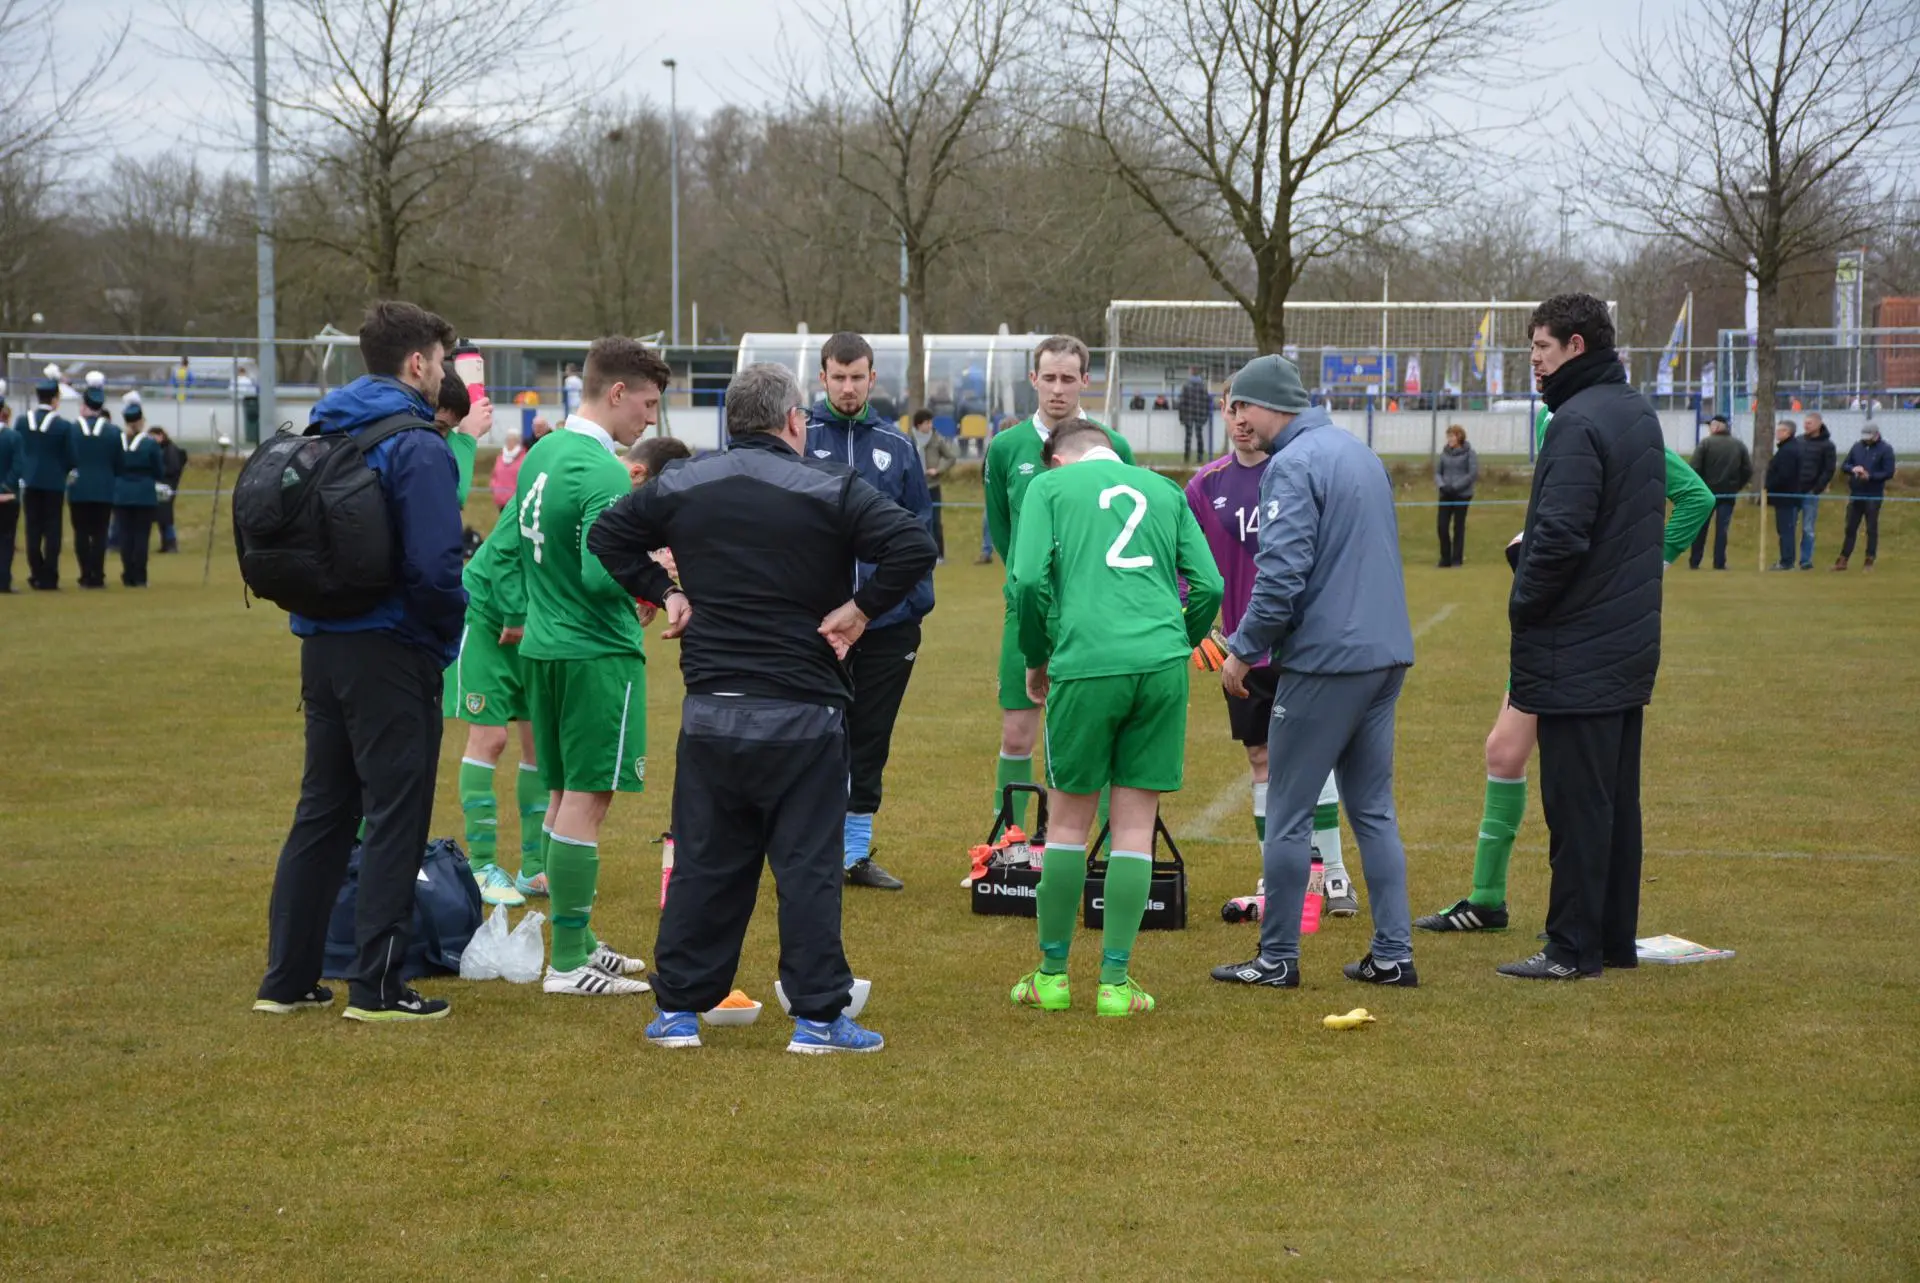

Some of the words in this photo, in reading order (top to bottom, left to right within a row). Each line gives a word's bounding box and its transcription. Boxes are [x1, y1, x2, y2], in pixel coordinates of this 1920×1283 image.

[519, 472, 548, 564] 4
[1098, 485, 1154, 569] 2
[977, 883, 991, 894] O
